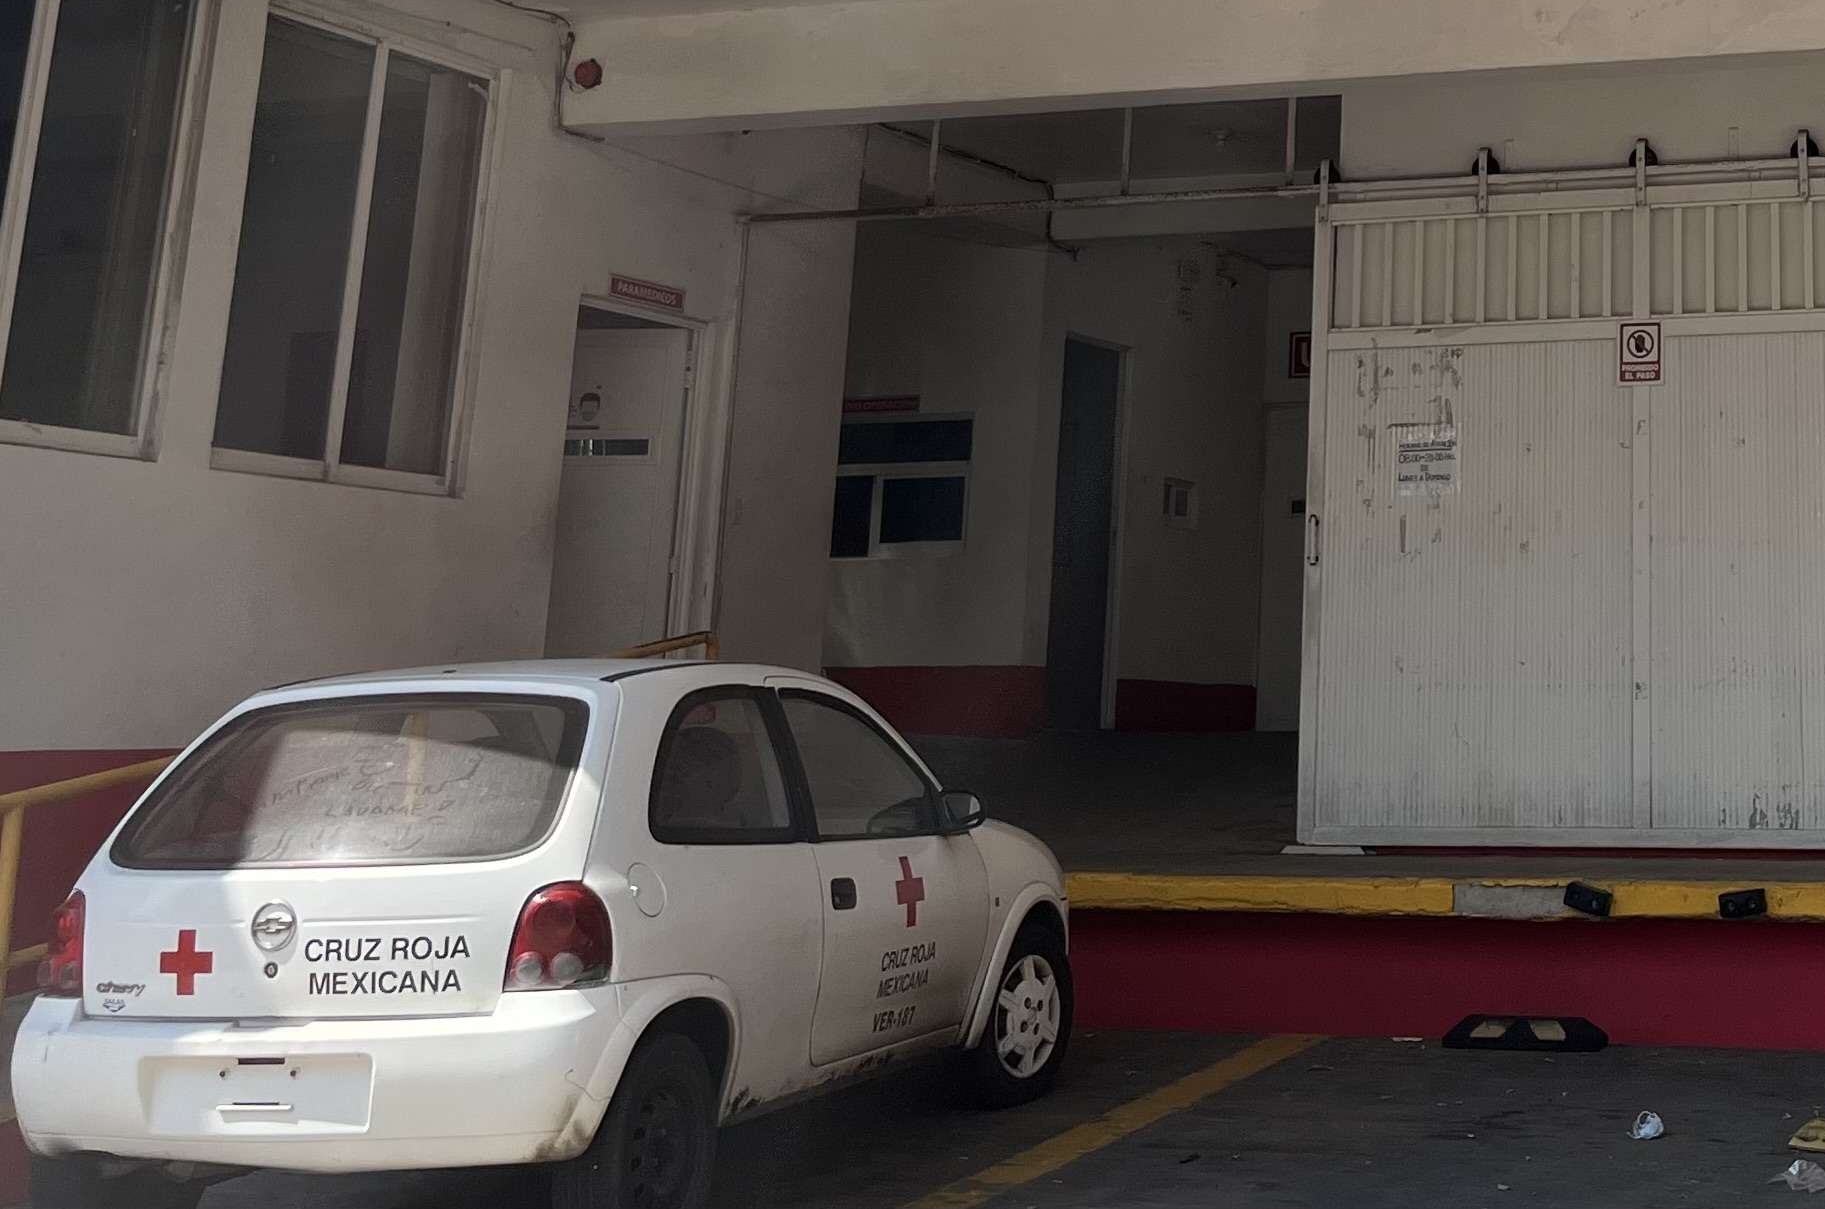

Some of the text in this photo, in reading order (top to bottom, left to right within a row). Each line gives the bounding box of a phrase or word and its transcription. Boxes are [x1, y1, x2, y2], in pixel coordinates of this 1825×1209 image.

[305, 935, 470, 962] CRUZ ROJA
[881, 941, 936, 972] CRUZ ROJA
[309, 968, 462, 995] MEXICANA
[876, 968, 929, 999] MEXICANA
